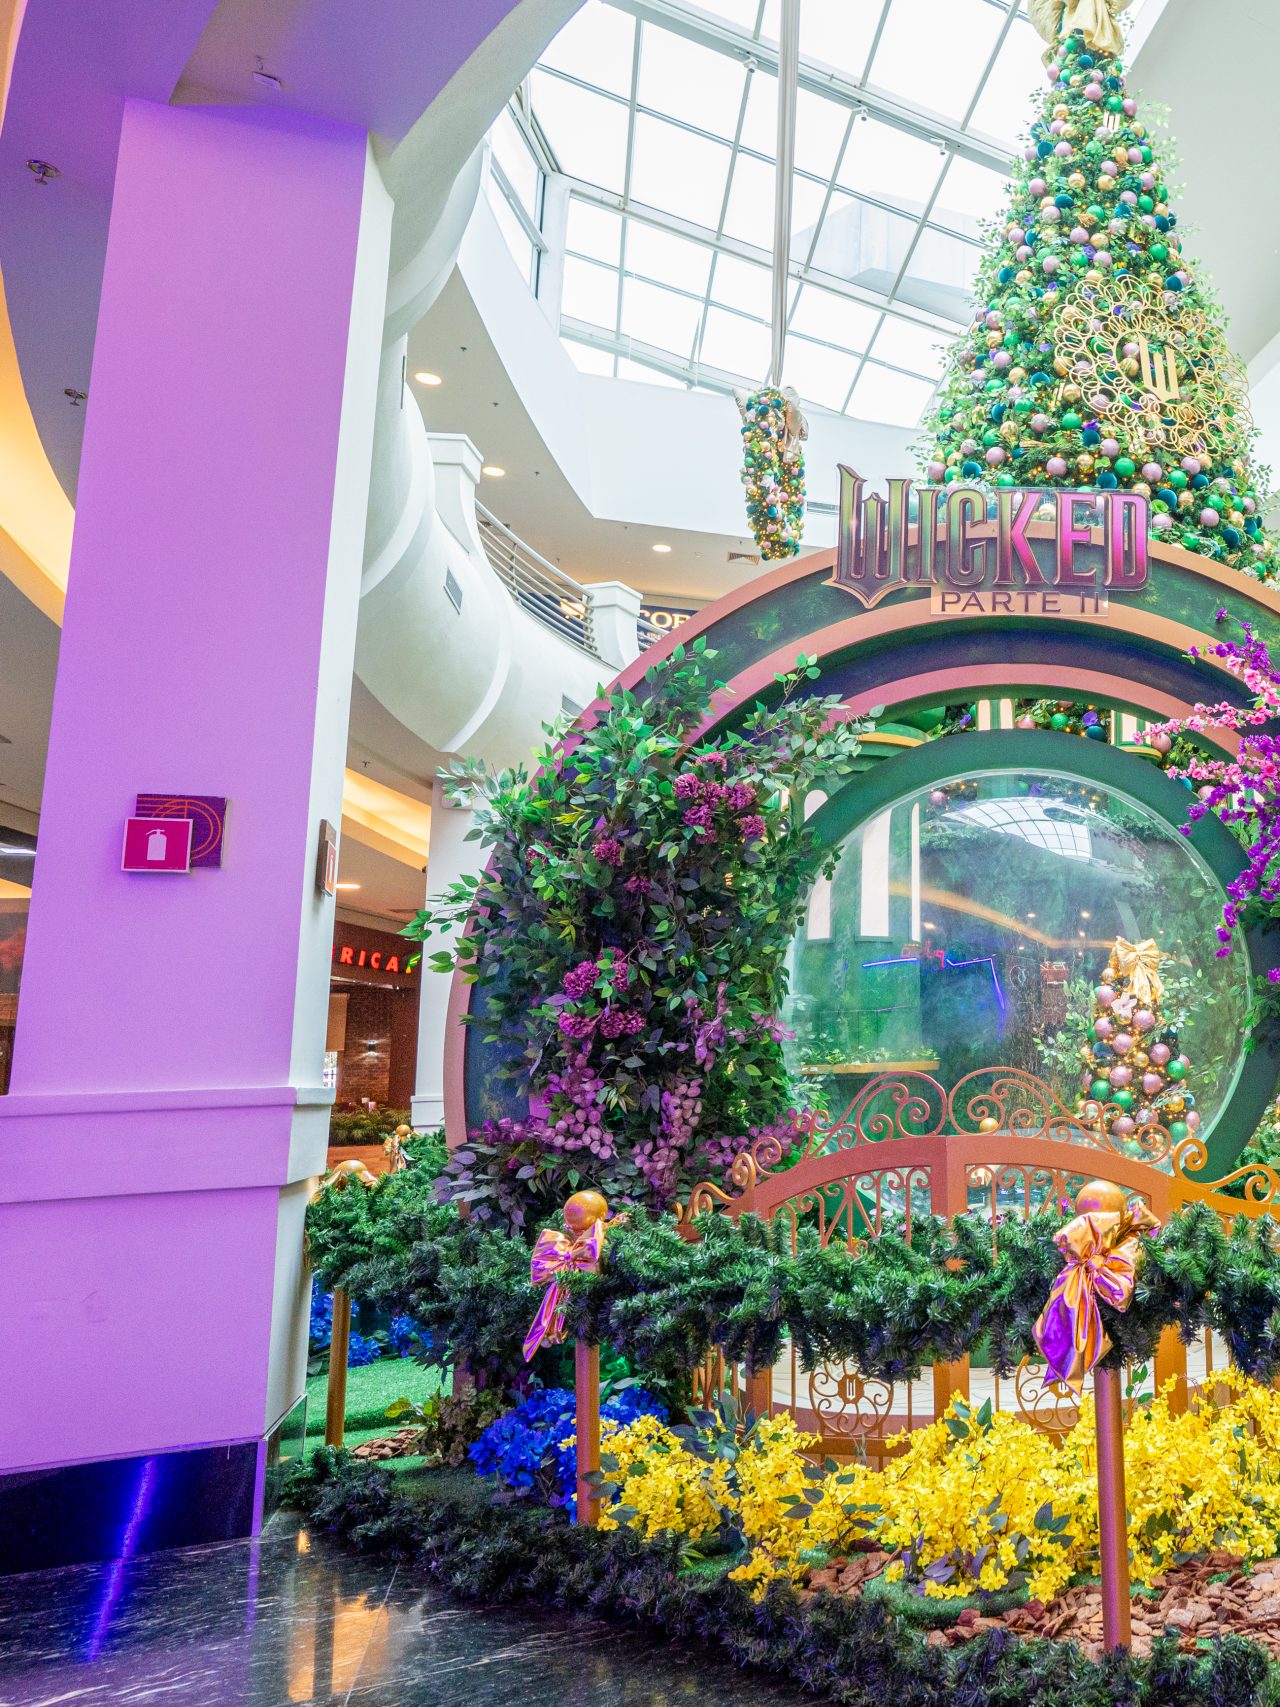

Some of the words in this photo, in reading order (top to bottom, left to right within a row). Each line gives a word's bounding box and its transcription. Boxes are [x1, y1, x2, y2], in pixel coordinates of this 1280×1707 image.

[833, 463, 1151, 606] WICKED
[941, 591, 1061, 612] PARTE
[1080, 592, 1099, 613] II
